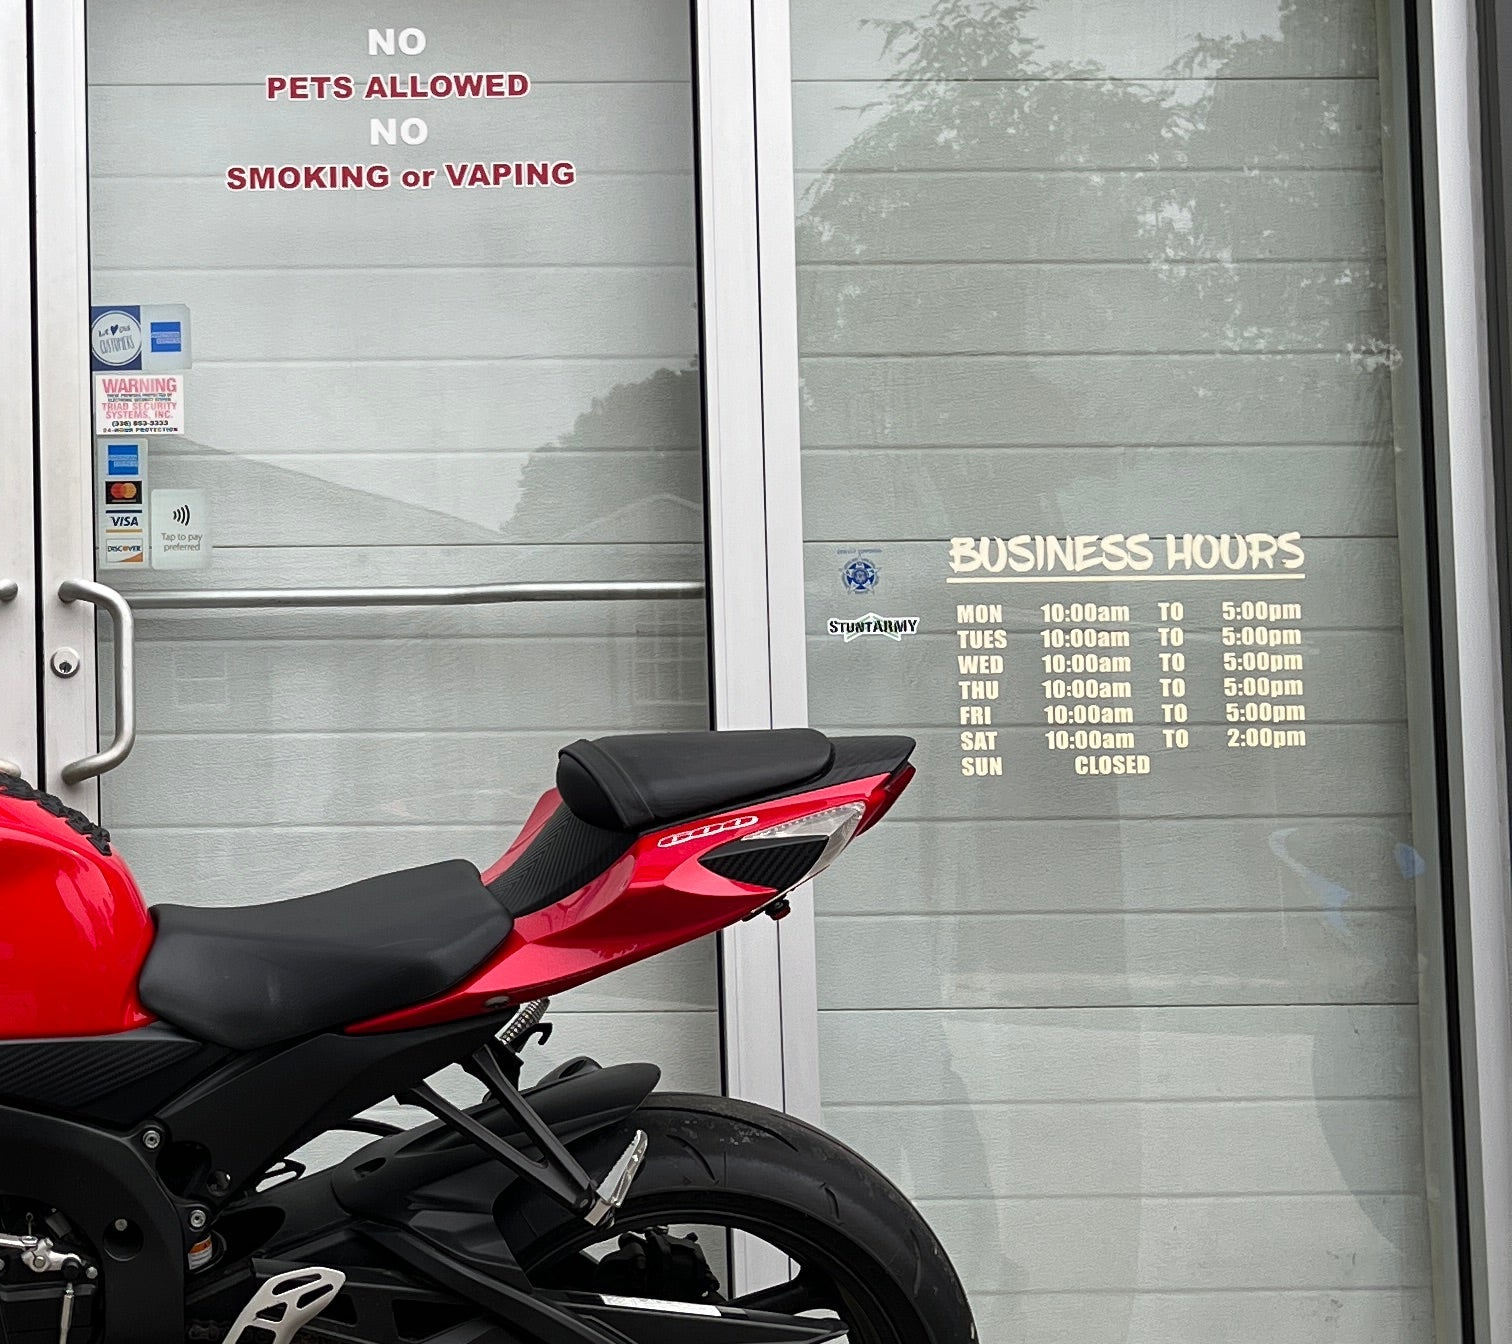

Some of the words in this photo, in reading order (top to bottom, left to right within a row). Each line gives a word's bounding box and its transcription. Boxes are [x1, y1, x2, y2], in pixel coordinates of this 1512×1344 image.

[368, 28, 426, 56] NO
[267, 76, 353, 99] PETS
[365, 74, 529, 99] ALLOWED
[370, 117, 428, 145] NO
[226, 165, 389, 190] SMOKING
[402, 168, 435, 187] or
[446, 163, 575, 187] VAPING
[102, 378, 177, 393] WARNING
[134, 402, 177, 410] SECURITY
[111, 516, 139, 527] VISA
[162, 532, 175, 541] Tap
[188, 534, 203, 542] pay
[164, 543, 200, 552] preferred
[948, 533, 1154, 573] BUSINESS
[1166, 531, 1305, 570] HOURS
[957, 604, 1002, 623] MON
[1041, 603, 1130, 623] 10:00am
[1159, 602, 1184, 621] TO
[1222, 601, 1302, 622] 5:00pm
[957, 630, 1008, 649] TUES
[1041, 628, 1130, 648] 10:00am
[1159, 627, 1184, 646] TO
[1222, 626, 1302, 647] 5:00pm
[958, 655, 1004, 675] WED
[1042, 654, 1131, 674] 10:00am
[1159, 652, 1185, 672] TO
[1223, 652, 1303, 672] 5:00pm
[959, 681, 999, 700] THU
[1042, 679, 1132, 699] 10:00am
[1160, 678, 1186, 697] TO
[1224, 677, 1304, 697] 5:00pm
[959, 706, 992, 725] FRI
[1043, 704, 1134, 724] 10:00am
[1162, 704, 1188, 723] TO
[1226, 703, 1306, 723] 5:00pm
[960, 732, 998, 751] SAT
[1045, 730, 1135, 750] 10:00am
[1163, 729, 1189, 748] TO
[1227, 728, 1306, 748] 2:00pm
[961, 757, 1003, 776] SUN
[1074, 755, 1151, 775] CLOSED
